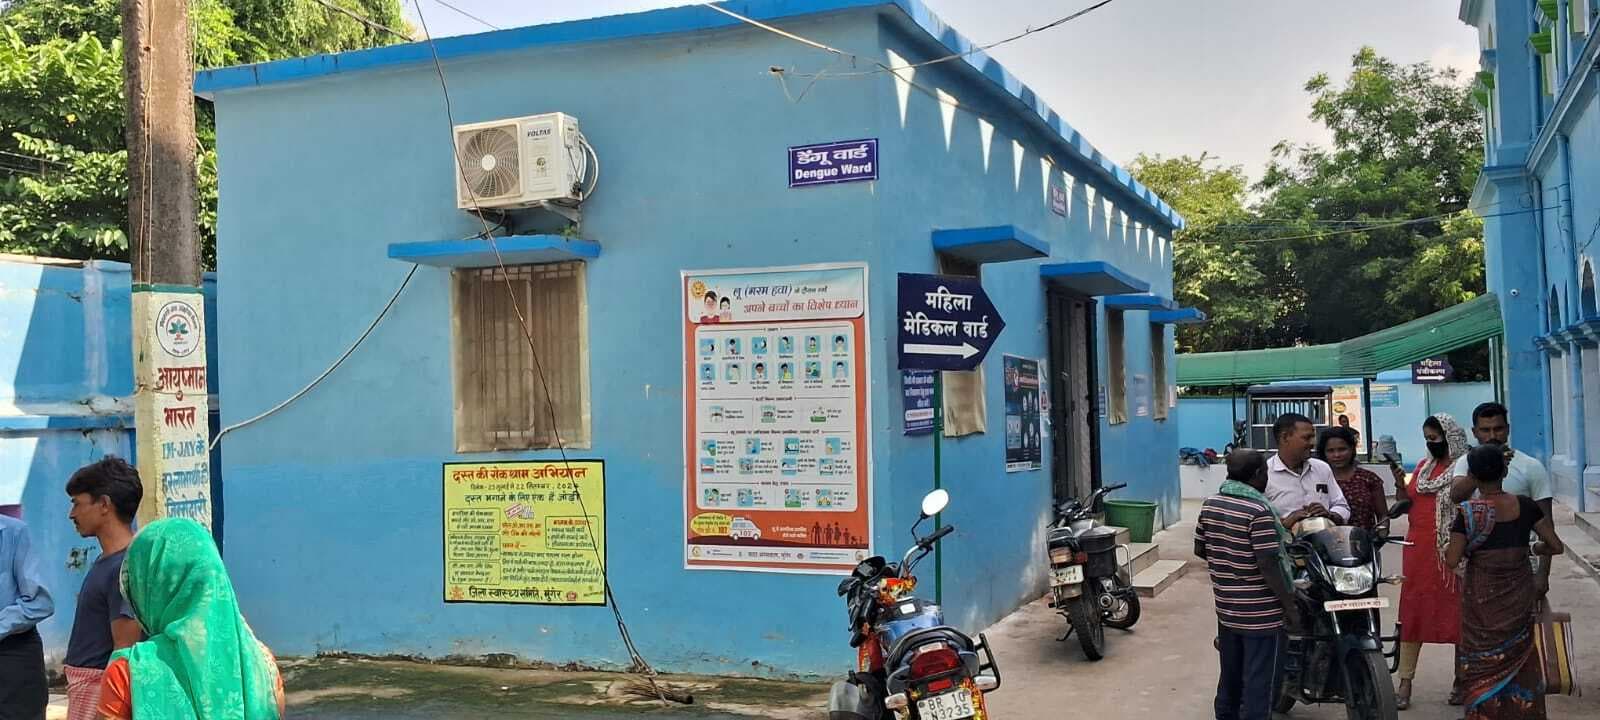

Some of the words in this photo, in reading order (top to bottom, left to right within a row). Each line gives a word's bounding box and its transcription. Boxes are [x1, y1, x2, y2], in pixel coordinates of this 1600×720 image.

[527, 128, 551, 137] VOLTAS
[832, 144, 869, 160] वार्ड
[795, 167, 838, 180] Dengue
[841, 162, 872, 175] Ward
[733, 287, 742, 300] लू
[925, 286, 973, 313] महिला
[744, 301, 765, 313] अपने
[792, 303, 804, 311] का
[807, 298, 832, 311] विशेष
[834, 298, 858, 310] ध्यान
[904, 311, 958, 337] मेडिकल
[963, 315, 989, 338] वार्ड
[156, 367, 205, 401] आयुष्मान
[164, 407, 196, 430] भारत
[453, 470, 474, 484] दस्त
[476, 466, 489, 480] की
[531, 465, 588, 480] अभियान
[465, 494, 482, 505] दस्त
[485, 492, 506, 502] भगाने
[508, 492, 517, 502] के
[469, 585, 487, 598] जिला
[489, 588, 520, 599] स्वास्थ्य
[544, 587, 562, 601] मुंगेर
[928, 697, 944, 711] BR
[952, 692, 967, 704] 10
